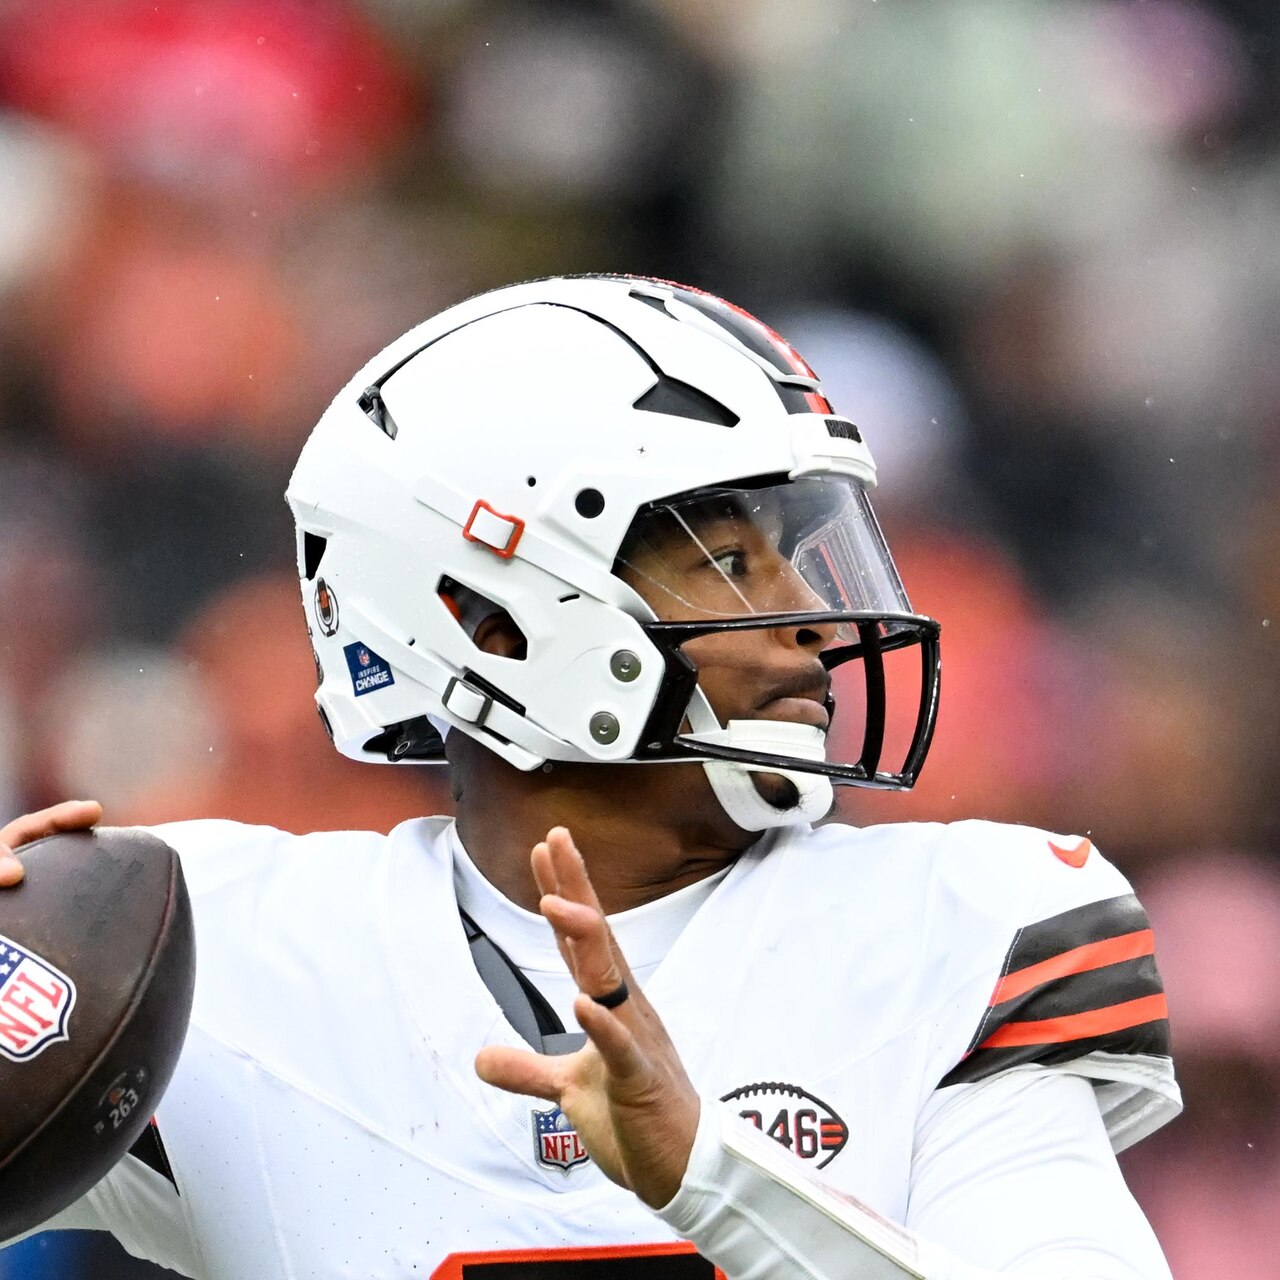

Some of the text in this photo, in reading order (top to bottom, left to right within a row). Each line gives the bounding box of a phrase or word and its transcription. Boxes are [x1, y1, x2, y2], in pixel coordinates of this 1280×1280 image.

[355, 671, 390, 691] CHANGE
[358, 665, 380, 679] INSPIRE
[109, 1088, 139, 1129] 263
[543, 1134, 586, 1163] NFL
